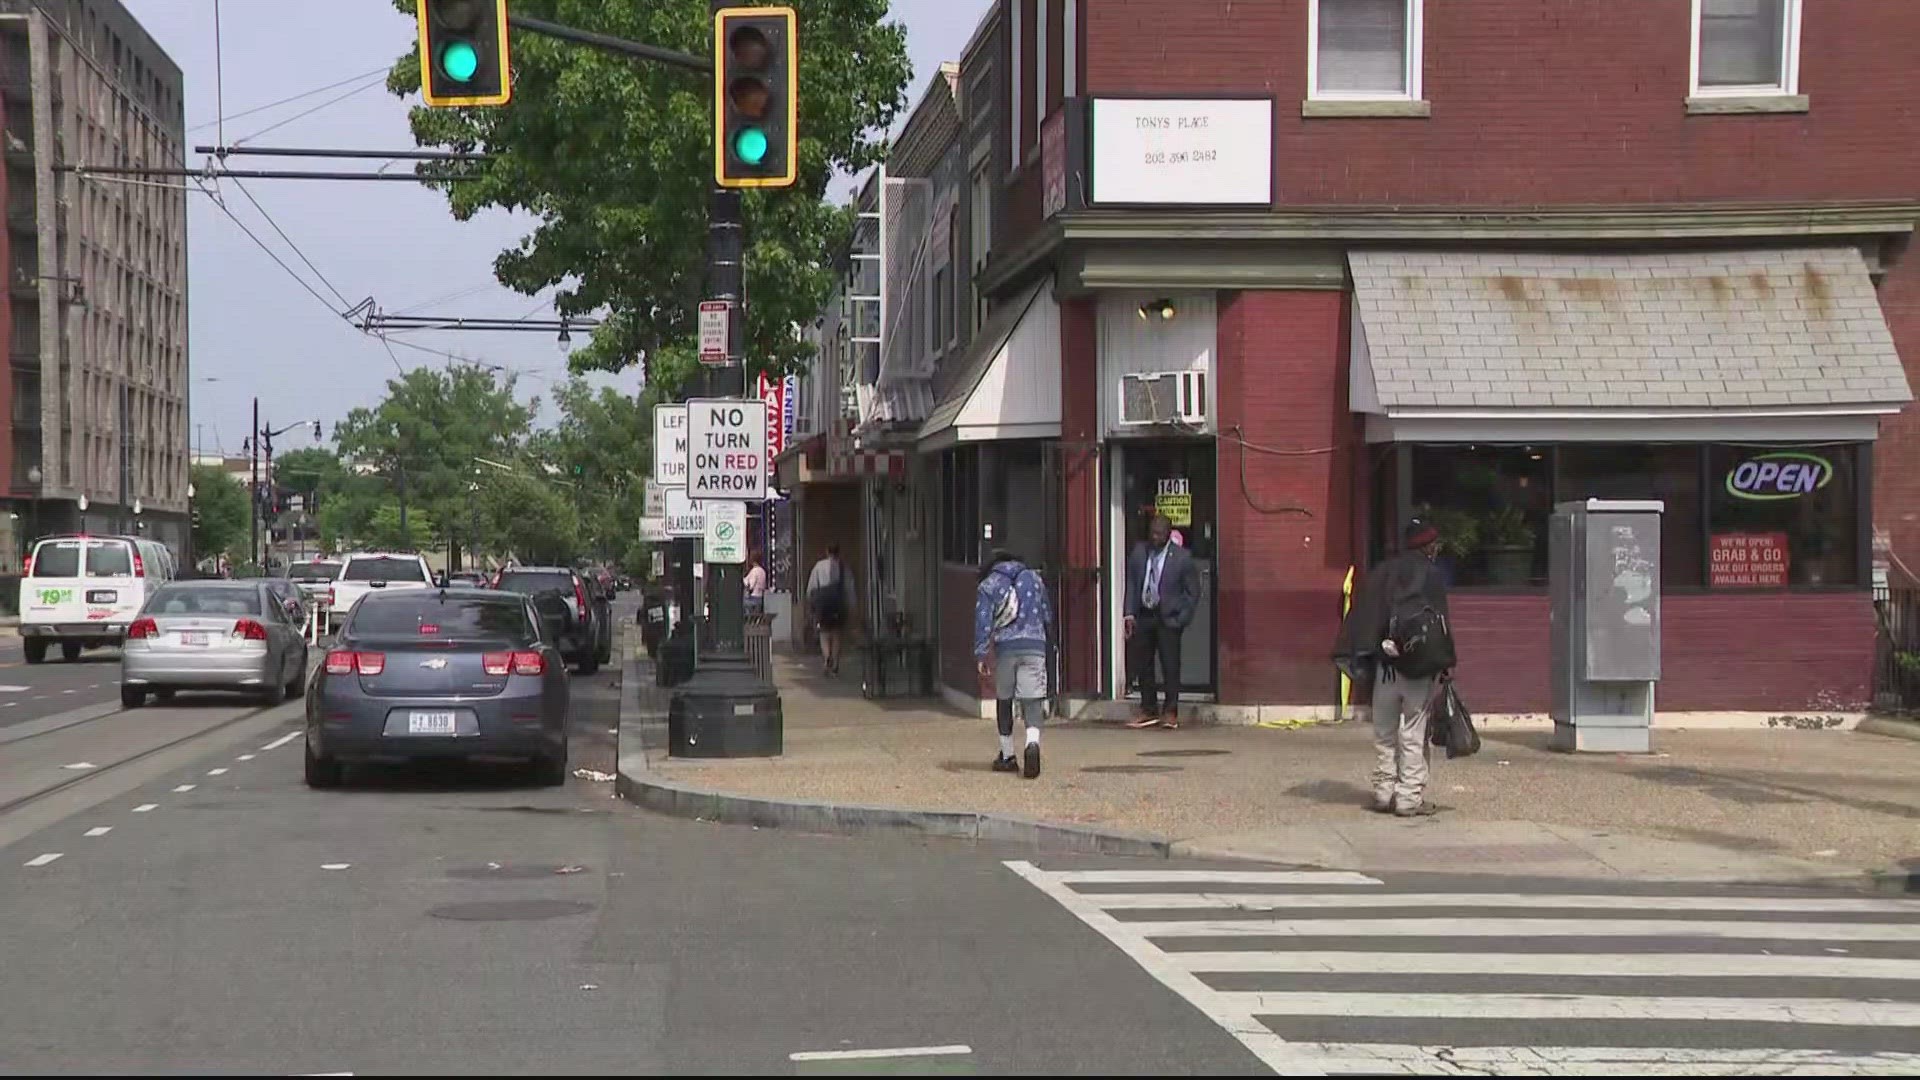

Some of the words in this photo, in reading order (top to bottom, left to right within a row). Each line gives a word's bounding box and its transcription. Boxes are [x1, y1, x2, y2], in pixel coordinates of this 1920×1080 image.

[1136, 117, 1170, 128] TONYS
[1178, 117, 1209, 128] PLACE
[1145, 152, 1165, 164] 202
[663, 416, 686, 429] LEF
[711, 408, 744, 427] NO
[704, 433, 750, 449] TURN
[696, 454, 719, 469] ON
[725, 455, 758, 470] RED
[662, 463, 685, 476] TUR
[697, 475, 757, 490] ARROW
[1733, 462, 1820, 492] OPEN
[1160, 479, 1188, 495] 1401
[668, 516, 704, 530] BLADENSB
[1713, 549, 1746, 561] GRAB
[1751, 549, 1759, 561] &
[1763, 549, 1781, 561] GO
[1711, 563, 1730, 572] TAKE
[1732, 563, 1748, 572] OUT
[1751, 563, 1785, 572] ORDERS
[1714, 575, 1758, 584] AVAILABLE
